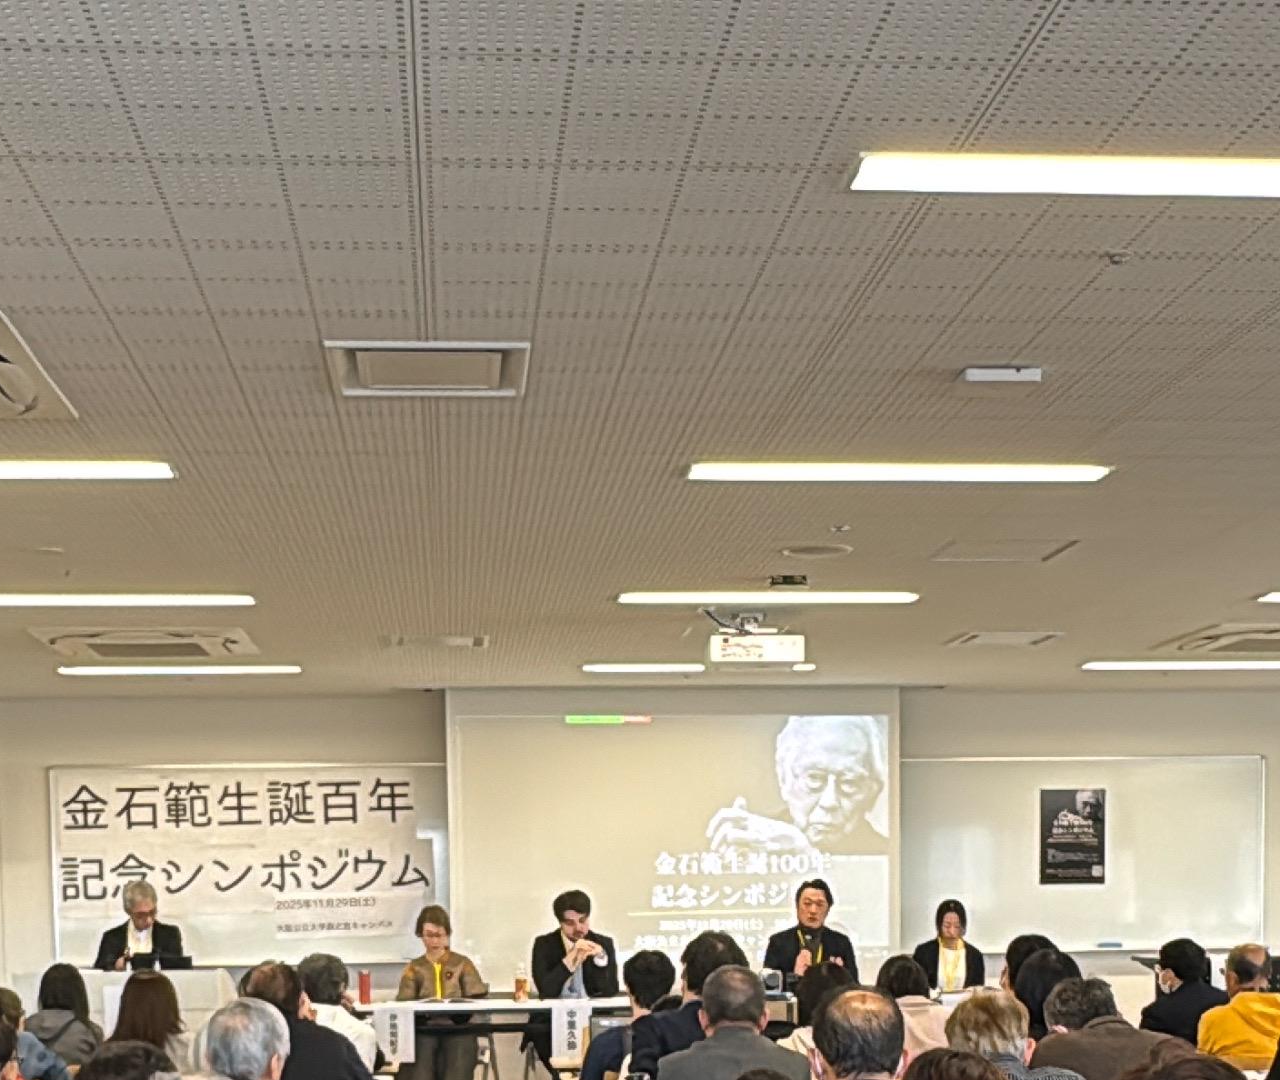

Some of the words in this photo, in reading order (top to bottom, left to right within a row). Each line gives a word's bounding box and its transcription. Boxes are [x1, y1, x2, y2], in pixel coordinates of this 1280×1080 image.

[61, 776, 416, 831] 金石範生誕百年
[651, 882, 788, 908] 記念シンポジ
